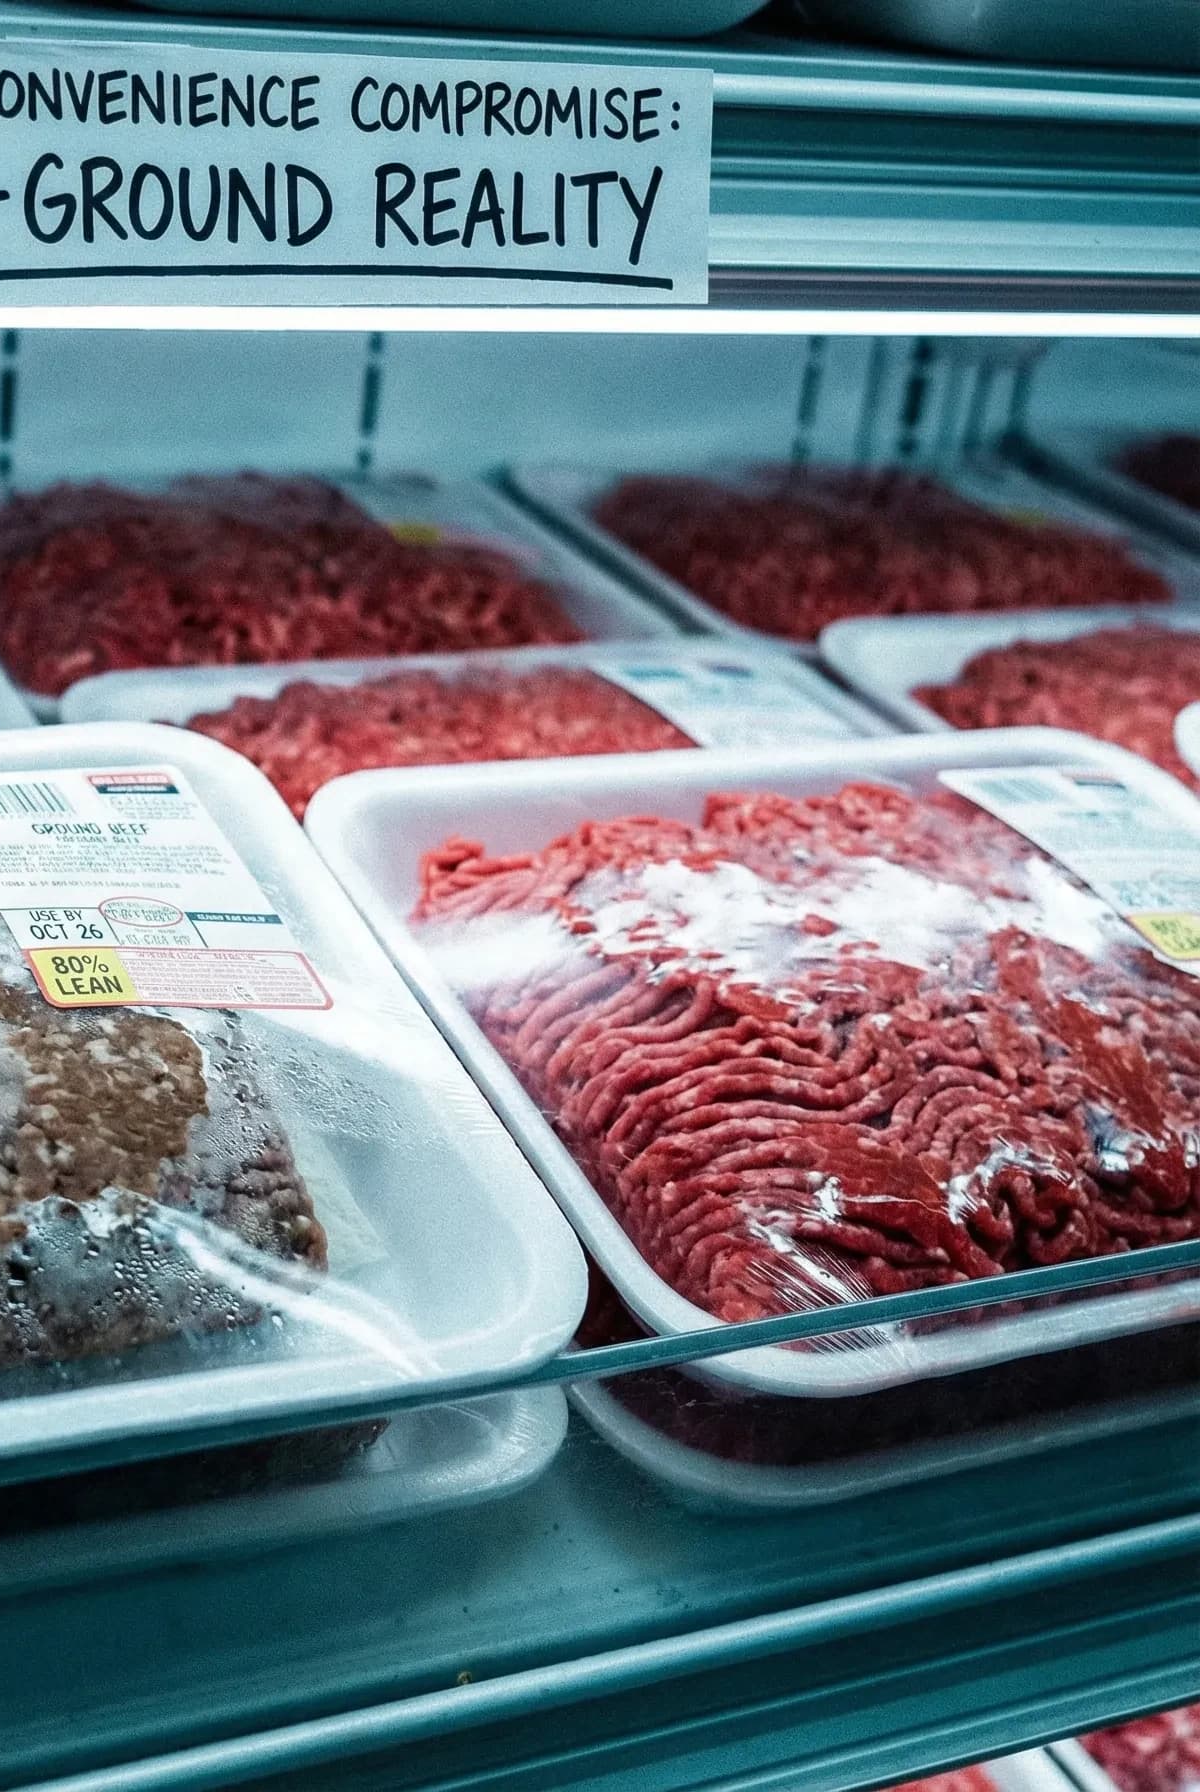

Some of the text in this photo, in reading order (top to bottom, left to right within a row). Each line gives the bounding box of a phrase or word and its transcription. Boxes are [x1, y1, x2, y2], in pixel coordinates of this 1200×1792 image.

[351, 77, 680, 142] COMPROMISE:
[375, 163, 663, 264] REALITY
[31, 823, 102, 835] GROUND
[29, 910, 82, 922] USE BY
[30, 924, 103, 940] OCT 26
[51, 955, 109, 975] 80%
[55, 976, 123, 996] LEAN
